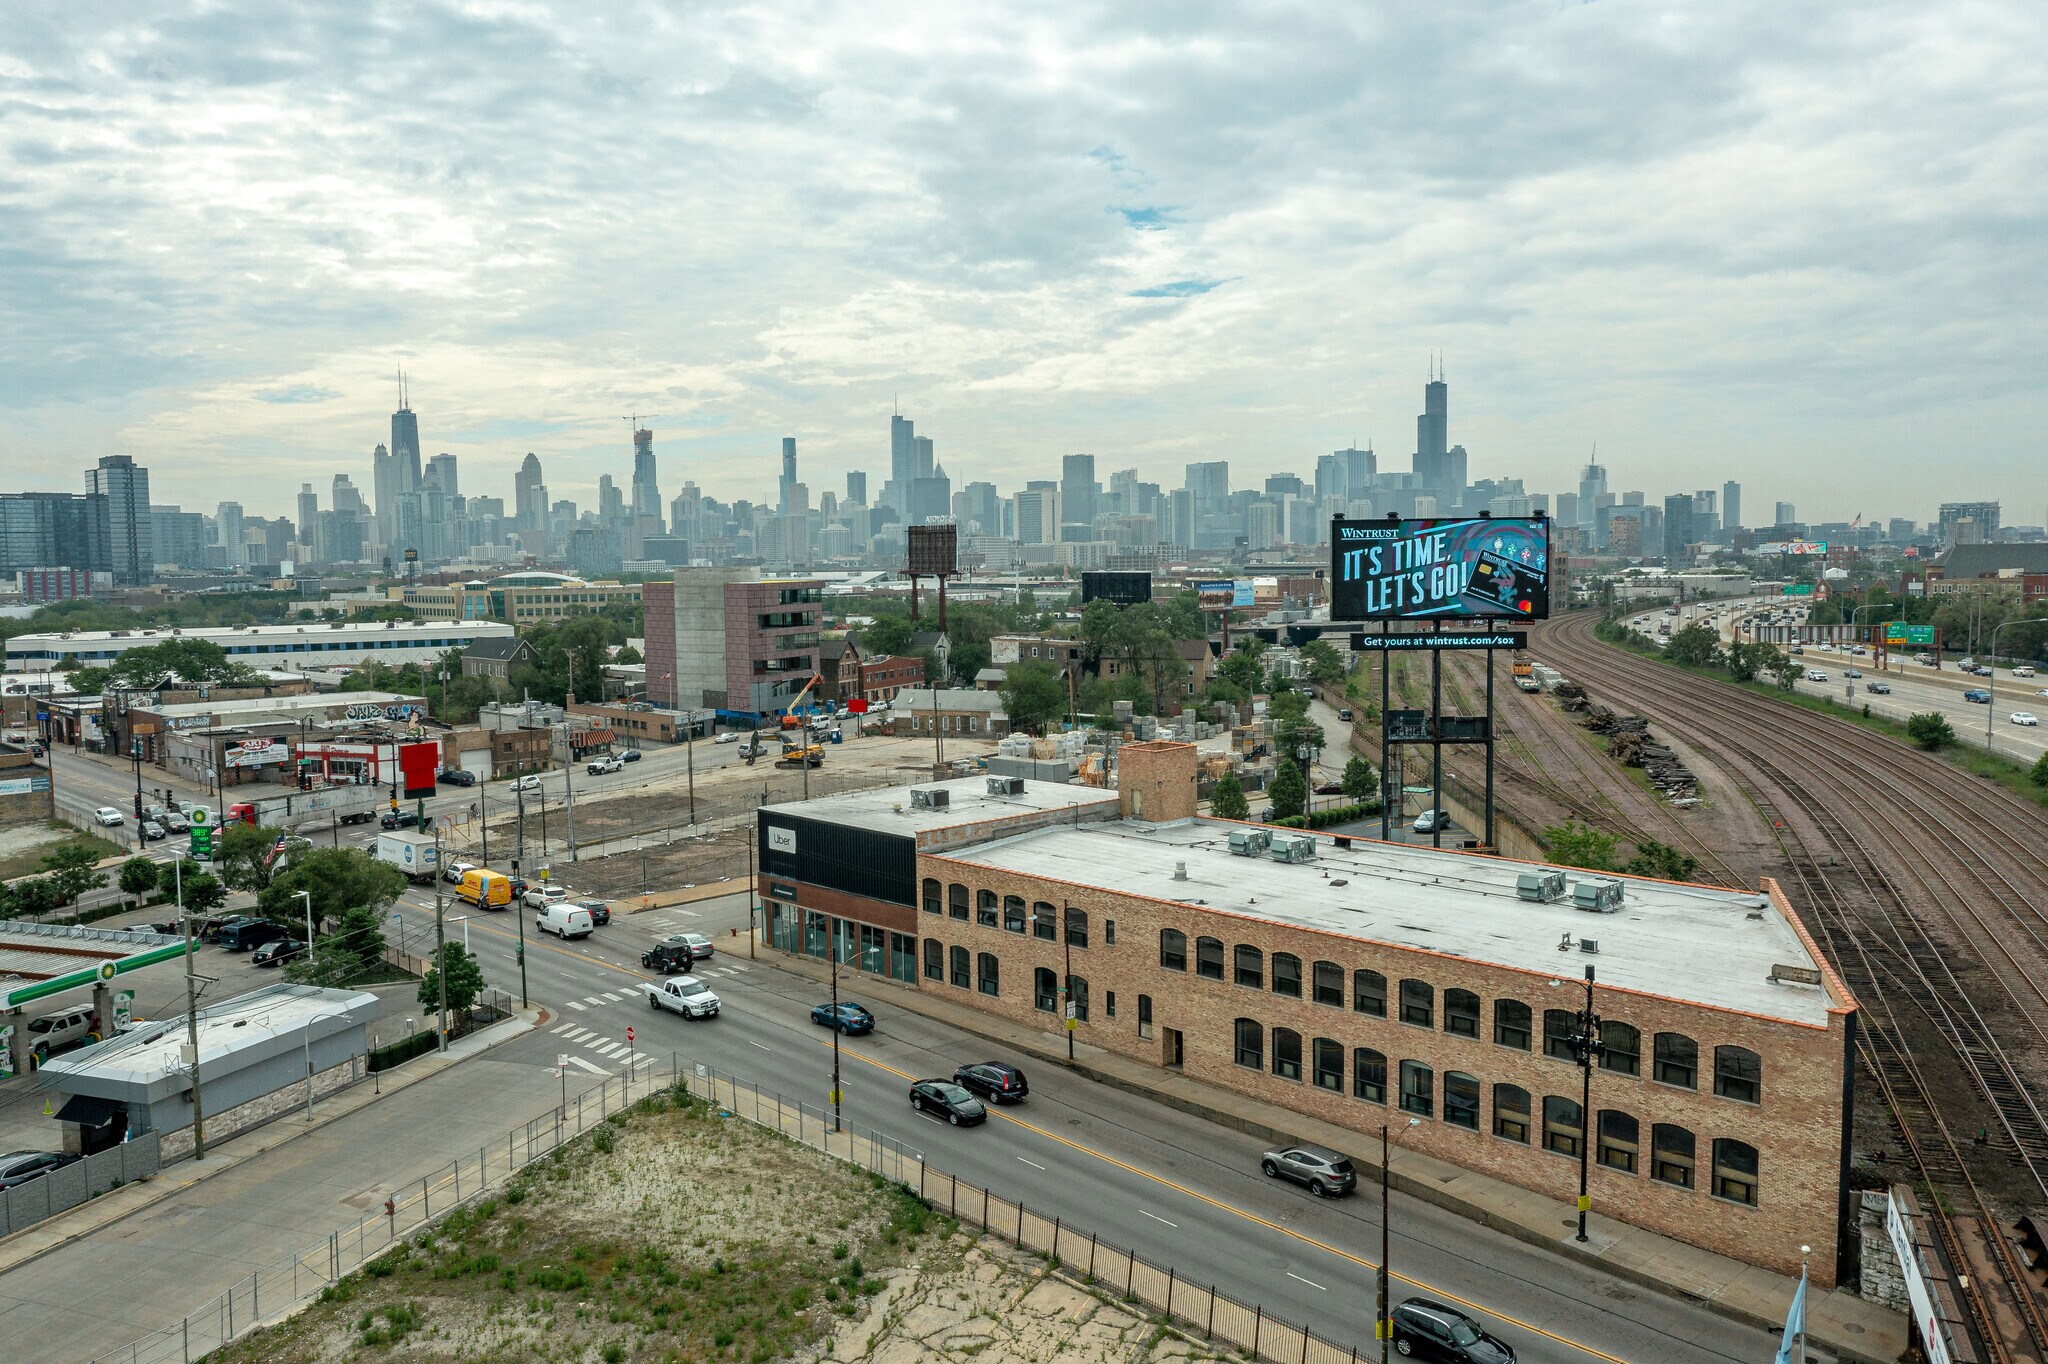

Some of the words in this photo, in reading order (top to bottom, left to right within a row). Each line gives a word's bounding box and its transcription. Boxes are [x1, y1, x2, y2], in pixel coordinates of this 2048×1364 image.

[1341, 528, 1399, 538] WINTRUST
[1344, 546, 1382, 581] IT'S
[1392, 533, 1451, 571] TIME,
[1366, 571, 1425, 612] LET'S
[1431, 562, 1467, 600] GO!
[1364, 637, 1381, 646] Get
[1384, 638, 1411, 648] yours
[1413, 637, 1423, 646] at
[1426, 636, 1514, 646] wintrust.com/sox
[773, 833, 791, 846] Uber
